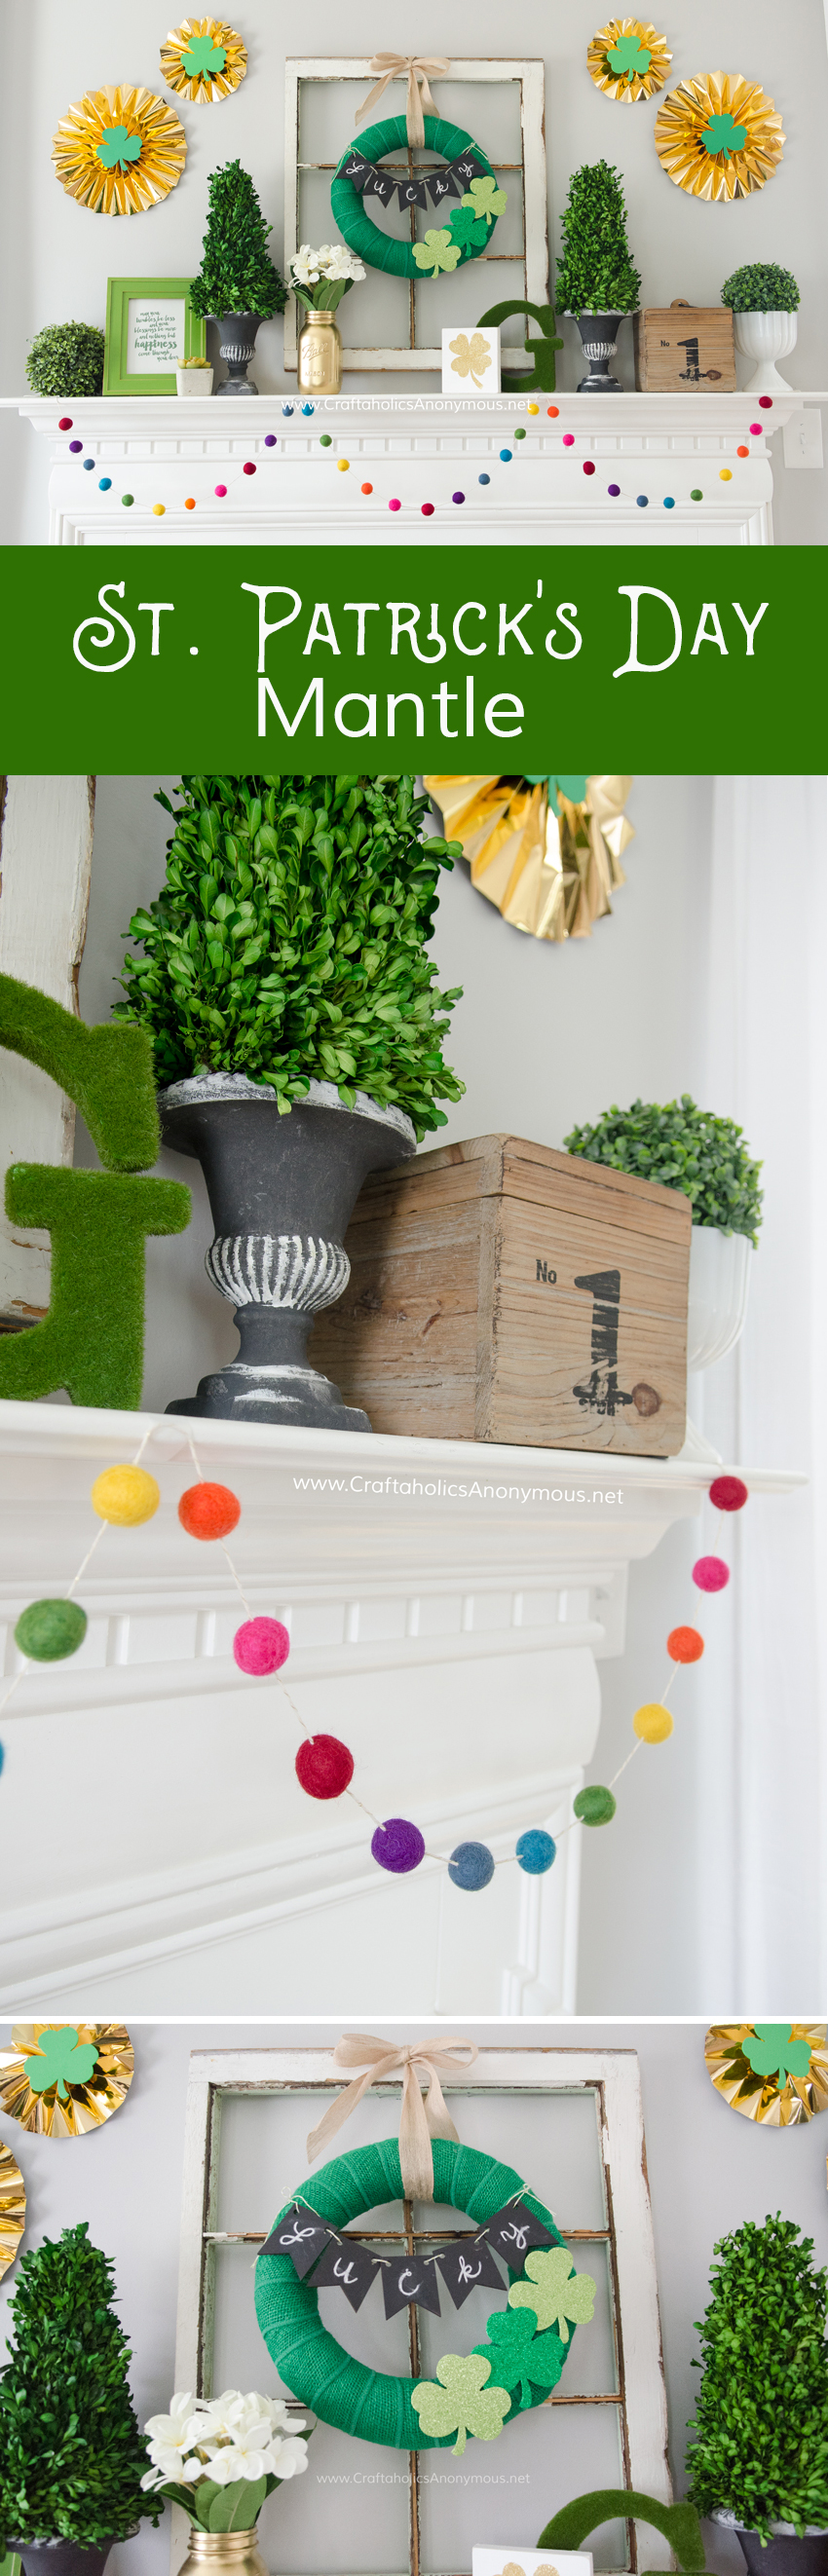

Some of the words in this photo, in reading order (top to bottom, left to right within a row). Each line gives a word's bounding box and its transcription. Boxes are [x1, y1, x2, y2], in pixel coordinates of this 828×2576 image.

[134, 338, 177, 352] happiness
[302, 343, 329, 361] Ball
[535, 1258, 557, 1285] No
